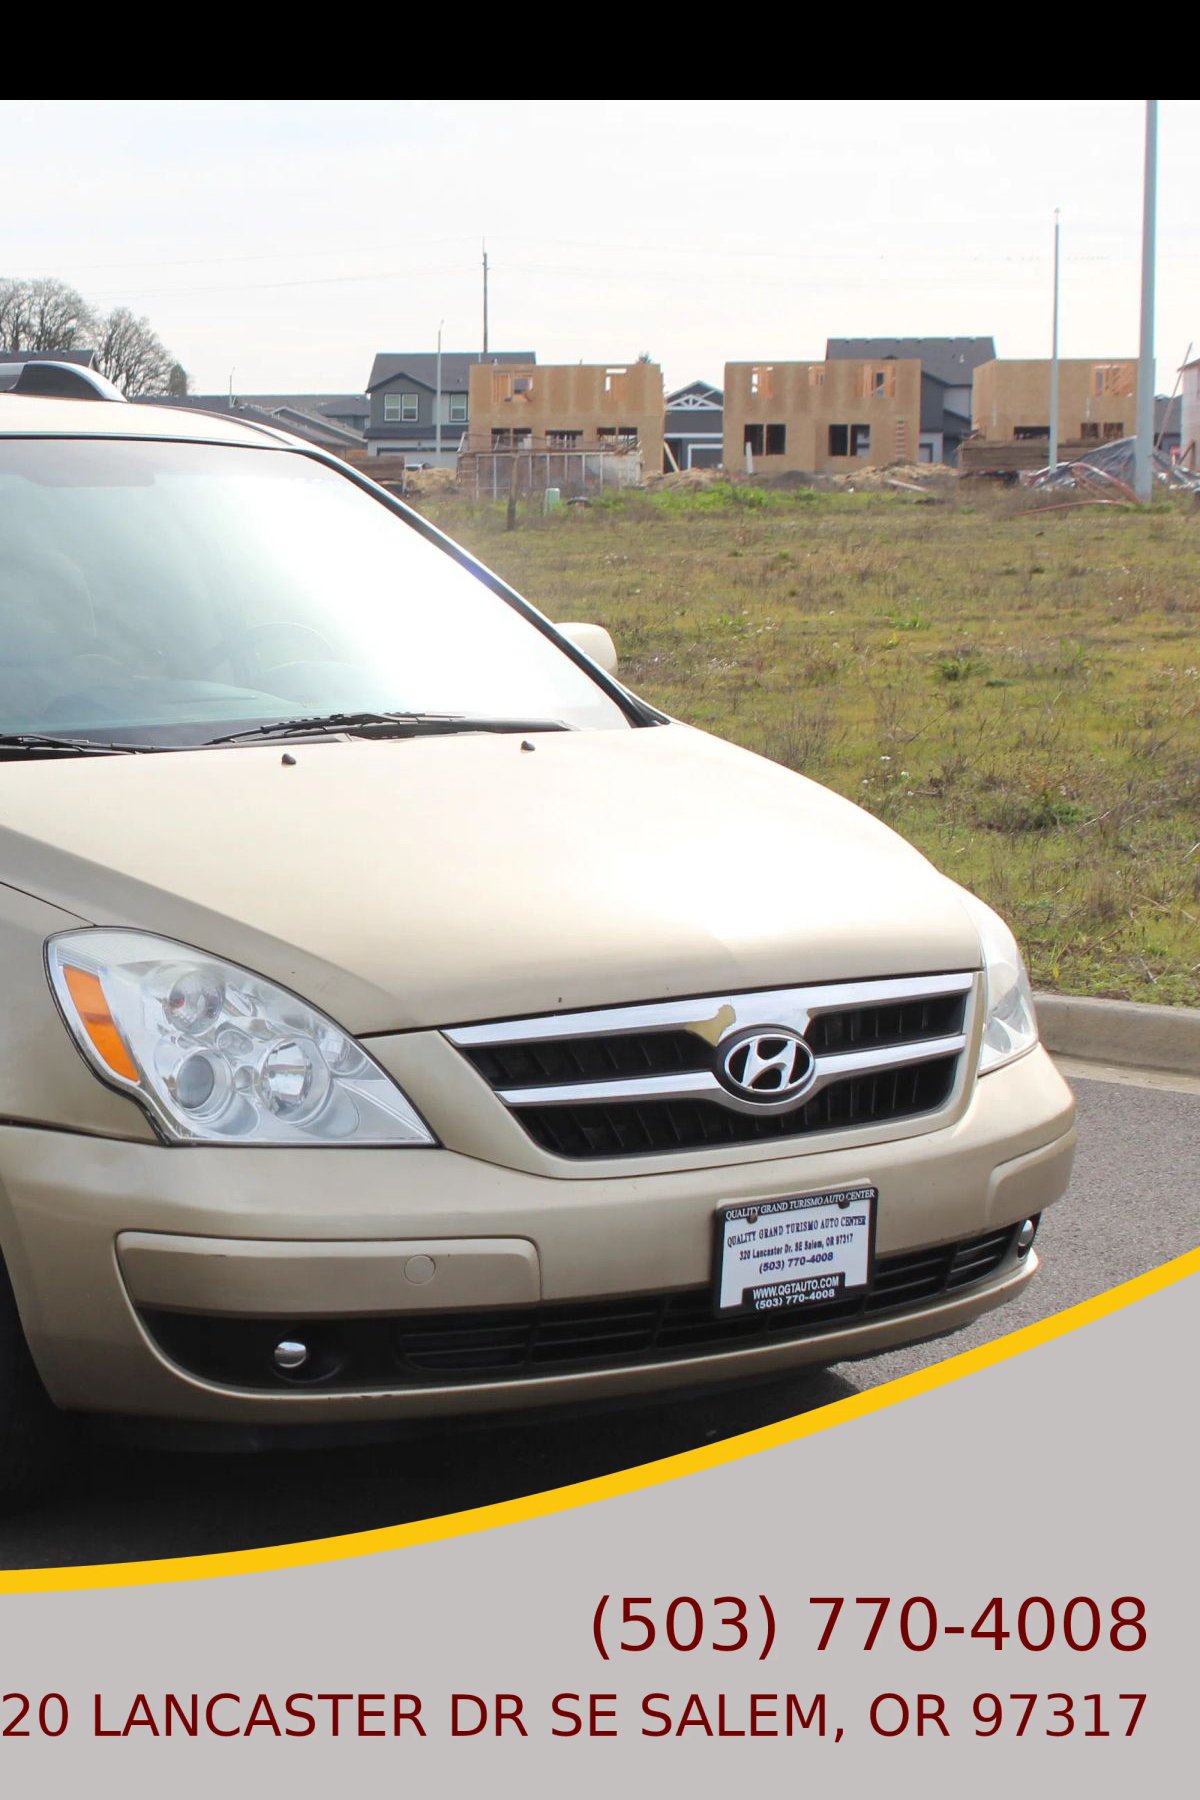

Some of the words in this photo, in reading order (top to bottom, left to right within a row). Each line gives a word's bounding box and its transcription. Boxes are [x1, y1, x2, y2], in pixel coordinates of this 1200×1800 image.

[726, 1206, 760, 1219] QUALITY
[761, 1202, 788, 1215] GRAND
[789, 1197, 823, 1209] TURISMO
[823, 1193, 844, 1204] AUTO
[846, 1189, 875, 1200] CENTER
[727, 1231, 756, 1248] QUALITY
[759, 1226, 783, 1240] GRAND
[786, 1220, 818, 1235] TURISMO
[821, 1217, 839, 1229] AUTO
[841, 1216, 866, 1227] CENTER
[740, 1249, 750, 1260] 320
[752, 1246, 782, 1258] Lancaster
[785, 1244, 793, 1253] Dr.
[795, 1242, 802, 1252] SE
[804, 1239, 823, 1250] Salem,
[826, 1238, 834, 1246] OR
[836, 1233, 853, 1245] 97317
[759, 1260, 785, 1273] (503)
[788, 1252, 833, 1267] 770-4008
[753, 1276, 839, 1299] WWW.QGTAUTO.COM
[756, 1297, 782, 1310] (503)
[786, 1290, 835, 1305] 770-4008
